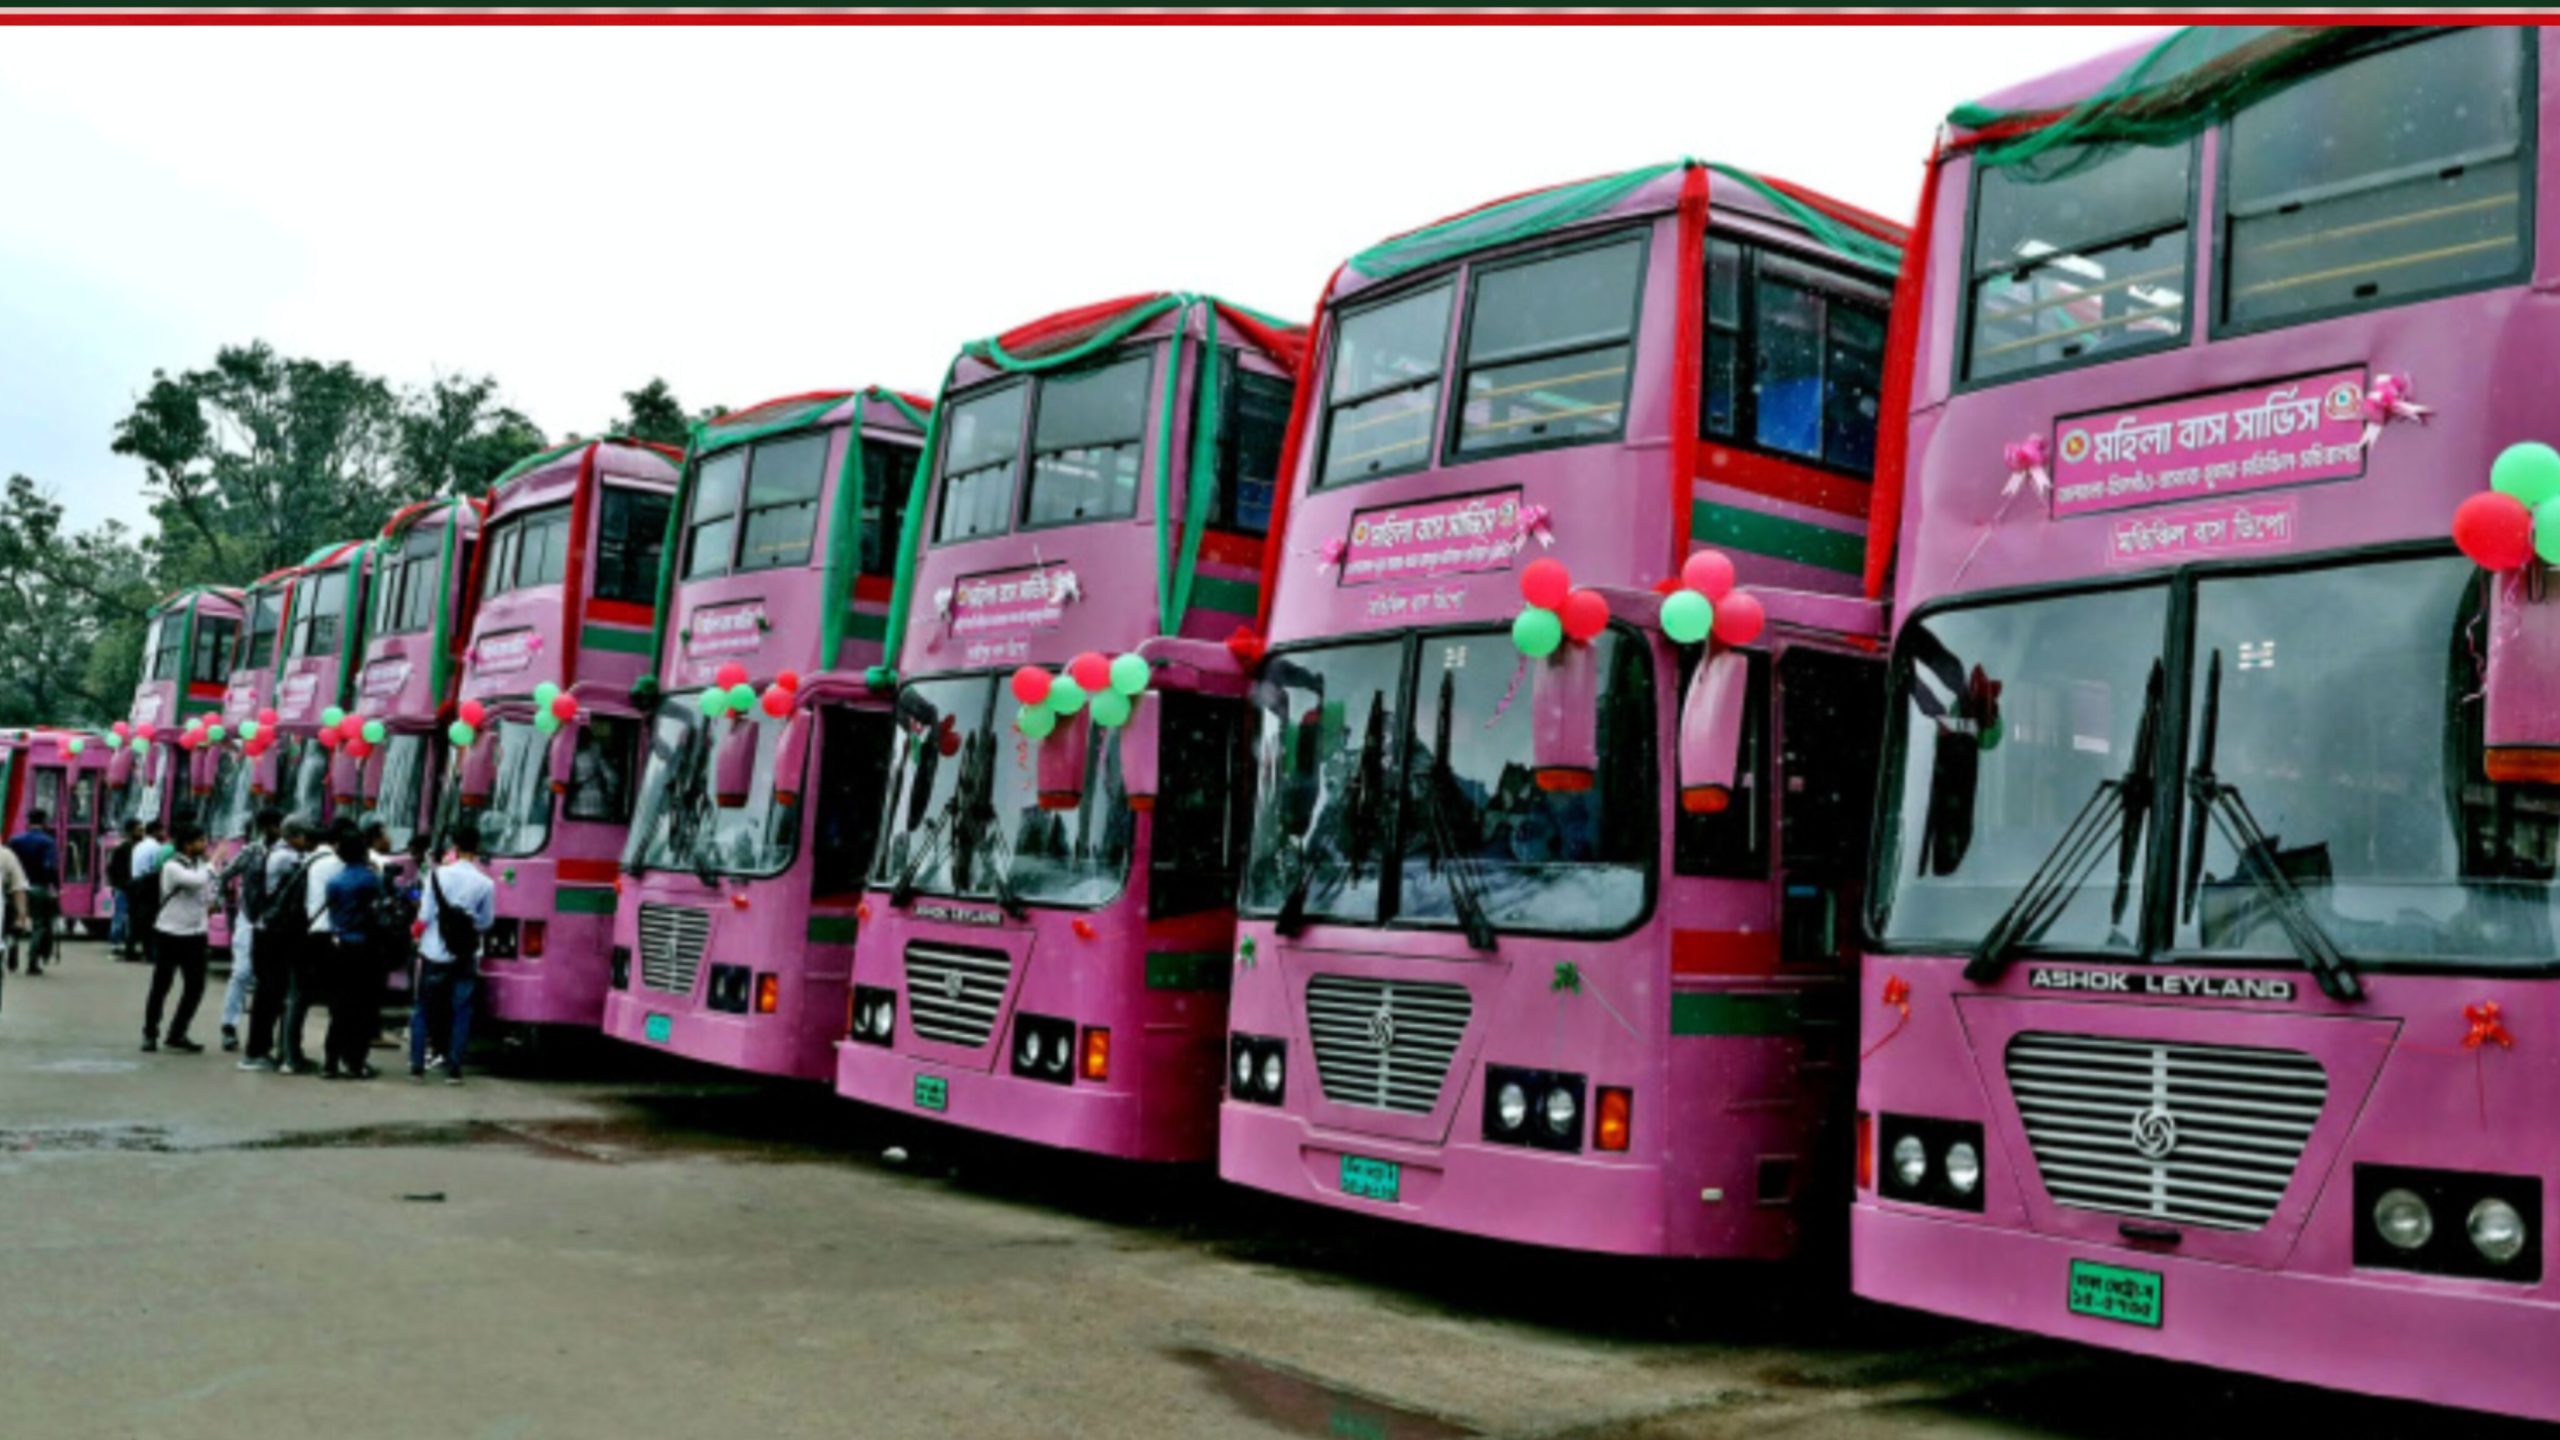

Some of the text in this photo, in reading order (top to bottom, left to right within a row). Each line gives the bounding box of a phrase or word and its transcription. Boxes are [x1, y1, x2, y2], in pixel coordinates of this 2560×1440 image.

[2094, 387, 2321, 465] মহিলা বাস সার্ভিস
[2032, 969, 2292, 999] ASHOK LEYLAND
